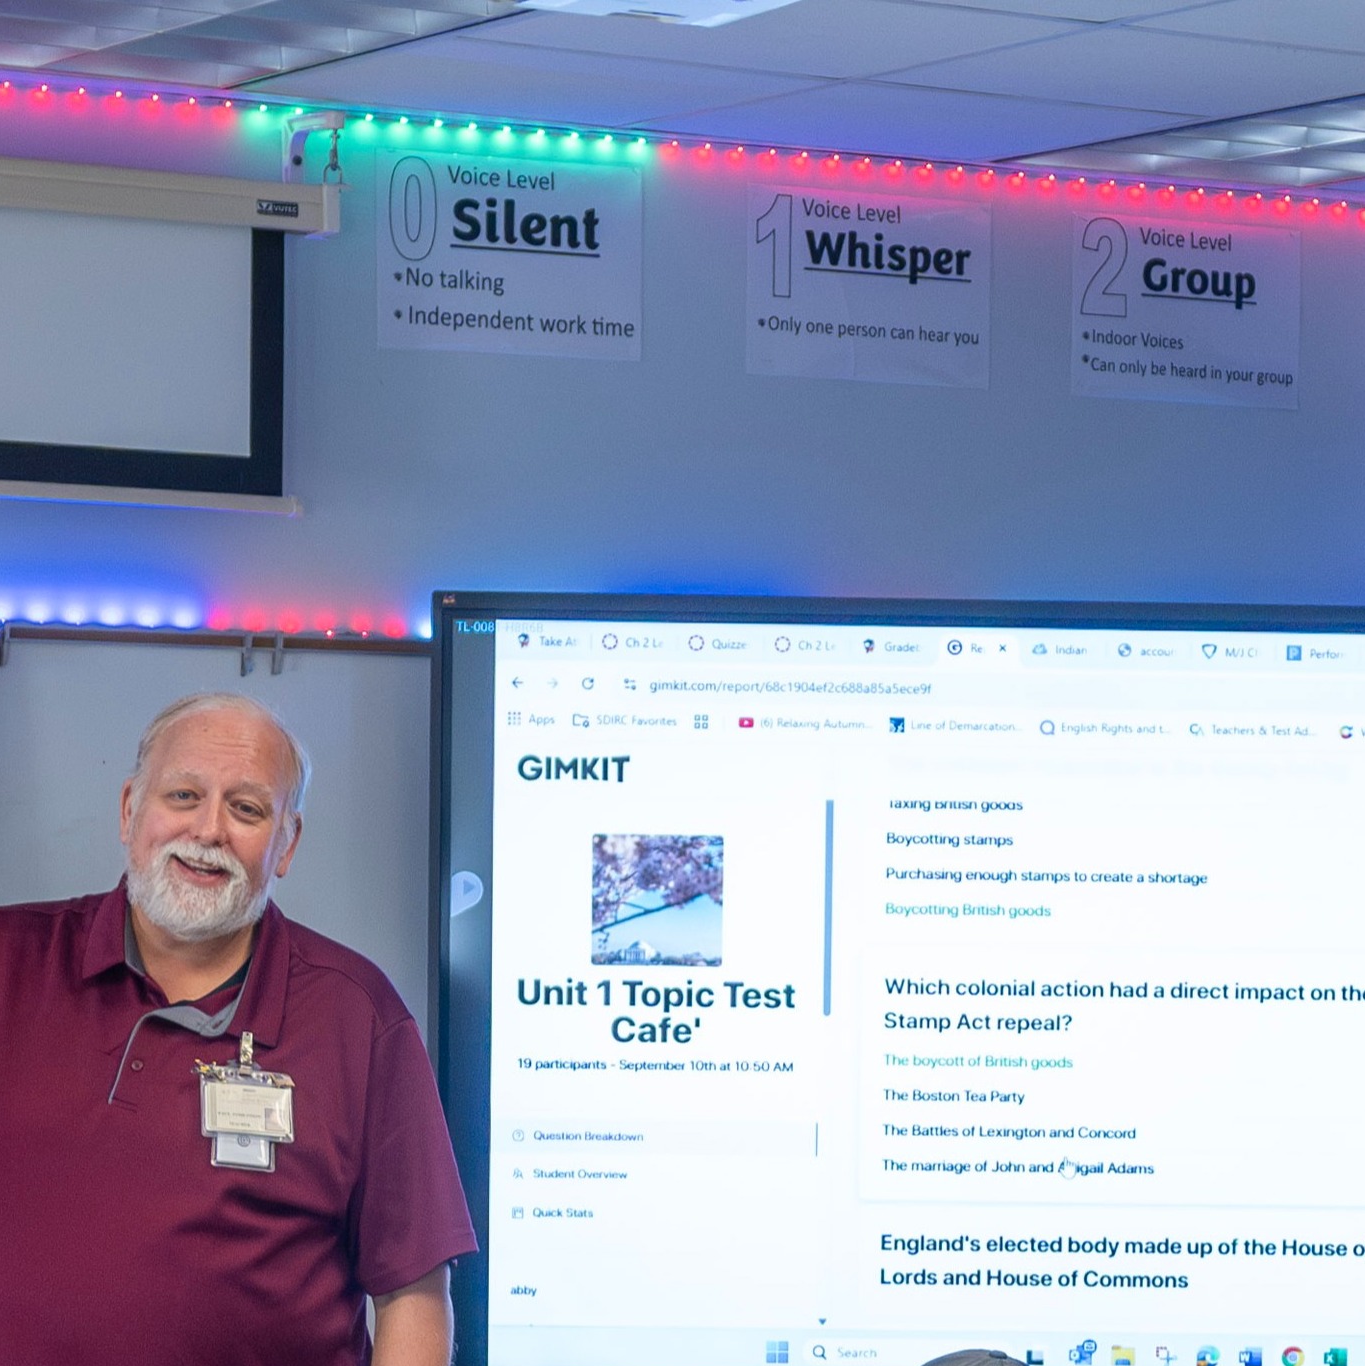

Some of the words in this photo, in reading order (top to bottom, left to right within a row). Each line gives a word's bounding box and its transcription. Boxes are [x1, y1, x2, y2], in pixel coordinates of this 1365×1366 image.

[448, 165, 500, 190] Voice
[506, 168, 554, 191] Level
[803, 198, 850, 220] Voice
[857, 202, 901, 224] Level
[451, 198, 600, 251] Silent
[1140, 227, 1185, 248] Voice
[1191, 231, 1232, 252] Level
[805, 229, 971, 284] Whisper
[406, 267, 434, 289] No
[439, 270, 504, 296] talking
[1141, 257, 1256, 309] Group
[408, 306, 533, 334] Independent
[540, 315, 587, 336] work
[593, 317, 634, 337] time
[768, 315, 801, 336] Only
[805, 320, 834, 336] one
[838, 321, 886, 341] person
[890, 325, 915, 340] can
[919, 323, 949, 342] hear
[953, 331, 979, 346] you
[1092, 330, 1136, 347] Indoor
[1141, 333, 1184, 349] Voices
[1091, 357, 1116, 373] Can
[1119, 357, 1147, 378] only
[1150, 360, 1166, 376] be
[1171, 361, 1207, 380] heard
[1211, 364, 1222, 380] in
[1226, 366, 1253, 386] your
[1257, 370, 1293, 386] group
[517, 754, 631, 783] GIMKIT
[886, 832, 960, 848] Boycotting
[963, 834, 1014, 849] stamps
[886, 867, 963, 884] Purchasing
[965, 869, 1018, 884] enough
[1020, 871, 1071, 885] stamps
[1074, 871, 1088, 883] to
[1090, 872, 1133, 883] create
[1136, 874, 1145, 883] a
[1147, 871, 1208, 887] shortage
[885, 902, 959, 919] Boycotting
[962, 903, 1006, 916] British
[1008, 905, 1052, 920] goods
[517, 977, 588, 1006] Unit
[596, 979, 611, 1007] 1
[621, 979, 715, 1014] Topic
[723, 981, 796, 1009] Test
[885, 978, 950, 996] Which
[955, 979, 1035, 997] colonial
[1040, 982, 1104, 998] action
[1109, 981, 1148, 998] had
[1153, 986, 1165, 999] a
[1170, 982, 1229, 1000] direct
[1234, 985, 1305, 1004] impact
[1310, 988, 1336, 1001] on
[611, 1016, 701, 1044] Cafe'
[884, 1011, 951, 1034] Stamp
[956, 1013, 991, 1030] Act
[997, 1014, 1073, 1035] repeal?
[885, 1053, 910, 1066] The
[912, 1054, 965, 1070] boycott
[967, 1055, 981, 1067] of
[984, 1055, 1028, 1068] British
[1030, 1056, 1074, 1071] goods
[885, 1088, 909, 1101] The
[912, 1089, 960, 1102] Boston
[965, 1090, 987, 1102] Tea
[990, 1090, 1025, 1106] Party
[884, 1124, 908, 1136] The
[911, 1124, 959, 1137] Battles
[961, 1125, 976, 1137] of
[979, 1125, 1046, 1141] Lexington
[1048, 1127, 1075, 1139] and
[1077, 1126, 1137, 1139] Concord
[880, 1234, 981, 1256] England's
[986, 1235, 1063, 1253] elected
[1067, 1236, 1120, 1258] body
[1124, 1237, 1182, 1255] made
[1187, 1242, 1213, 1259] up
[1217, 1238, 1238, 1255] of
[1243, 1238, 1277, 1256] the
[1282, 1239, 1348, 1257] House
[510, 1285, 537, 1297] abby
[880, 1268, 938, 1286] Lords
[942, 1269, 981, 1286] and
[986, 1269, 1053, 1287] House
[1057, 1270, 1078, 1287] of
[1083, 1270, 1189, 1289] Commons
